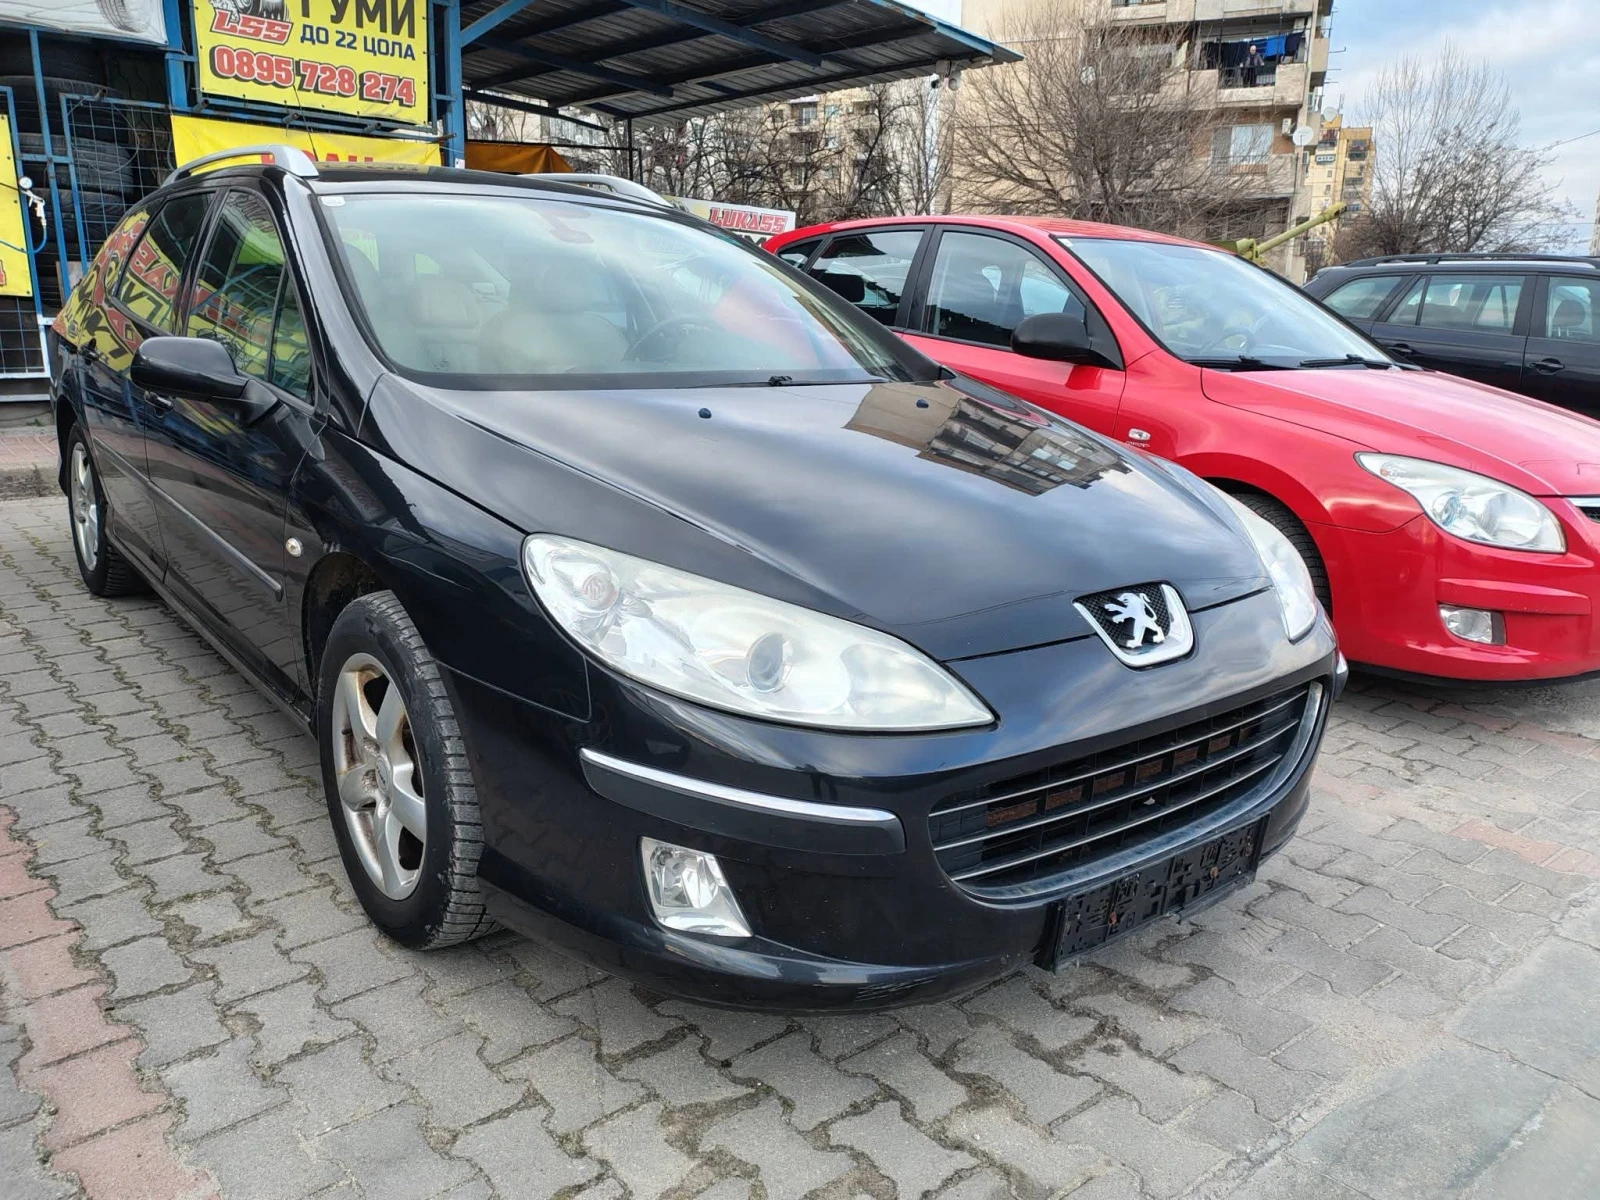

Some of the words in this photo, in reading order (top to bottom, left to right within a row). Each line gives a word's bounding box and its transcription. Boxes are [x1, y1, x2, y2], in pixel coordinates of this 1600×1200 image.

[210, 8, 294, 45] LSS
[300, 24, 329, 45] ДО
[335, 30, 357, 50] 22
[363, 36, 415, 61] ЦОЛА
[210, 45, 294, 88] 0895
[297, 60, 357, 97] 728
[360, 71, 416, 107] 274
[709, 206, 788, 234] LUKASS
